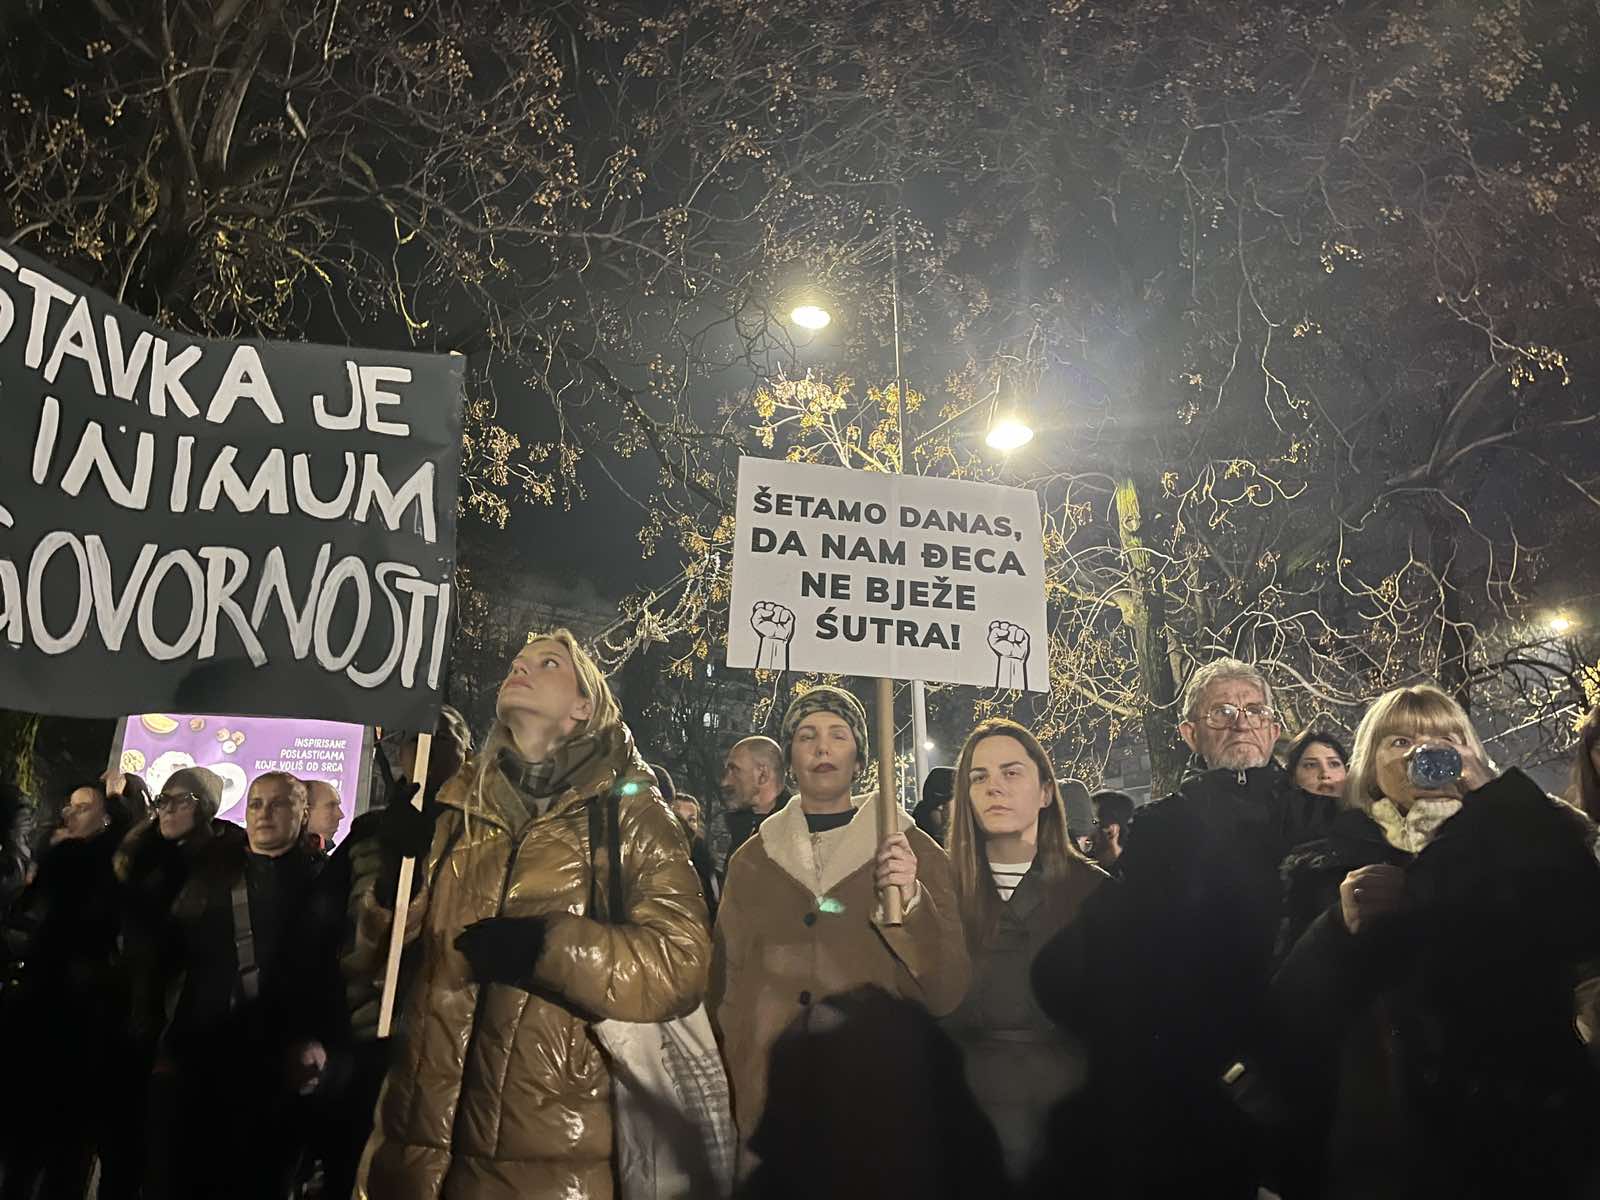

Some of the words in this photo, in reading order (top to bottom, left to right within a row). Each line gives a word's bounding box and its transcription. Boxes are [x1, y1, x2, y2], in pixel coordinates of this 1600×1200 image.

[312, 360, 412, 436] JE
[753, 486, 887, 524] ŠETAMO
[900, 506, 1022, 542] DANAS,
[751, 528, 807, 557] DA
[822, 533, 906, 566] NAM
[921, 543, 1026, 576] ĐECA
[801, 571, 851, 600] NE
[867, 576, 976, 611] BJEŽE
[816, 607, 961, 650] ŚUTRA!
[281, 749, 344, 760] POSLASTICAMA
[294, 738, 347, 748] INSPIRISANE
[255, 760, 276, 769] KOJE
[280, 761, 303, 771] VOLIŠ
[306, 763, 318, 771] OD
[321, 763, 343, 772] SRCA
